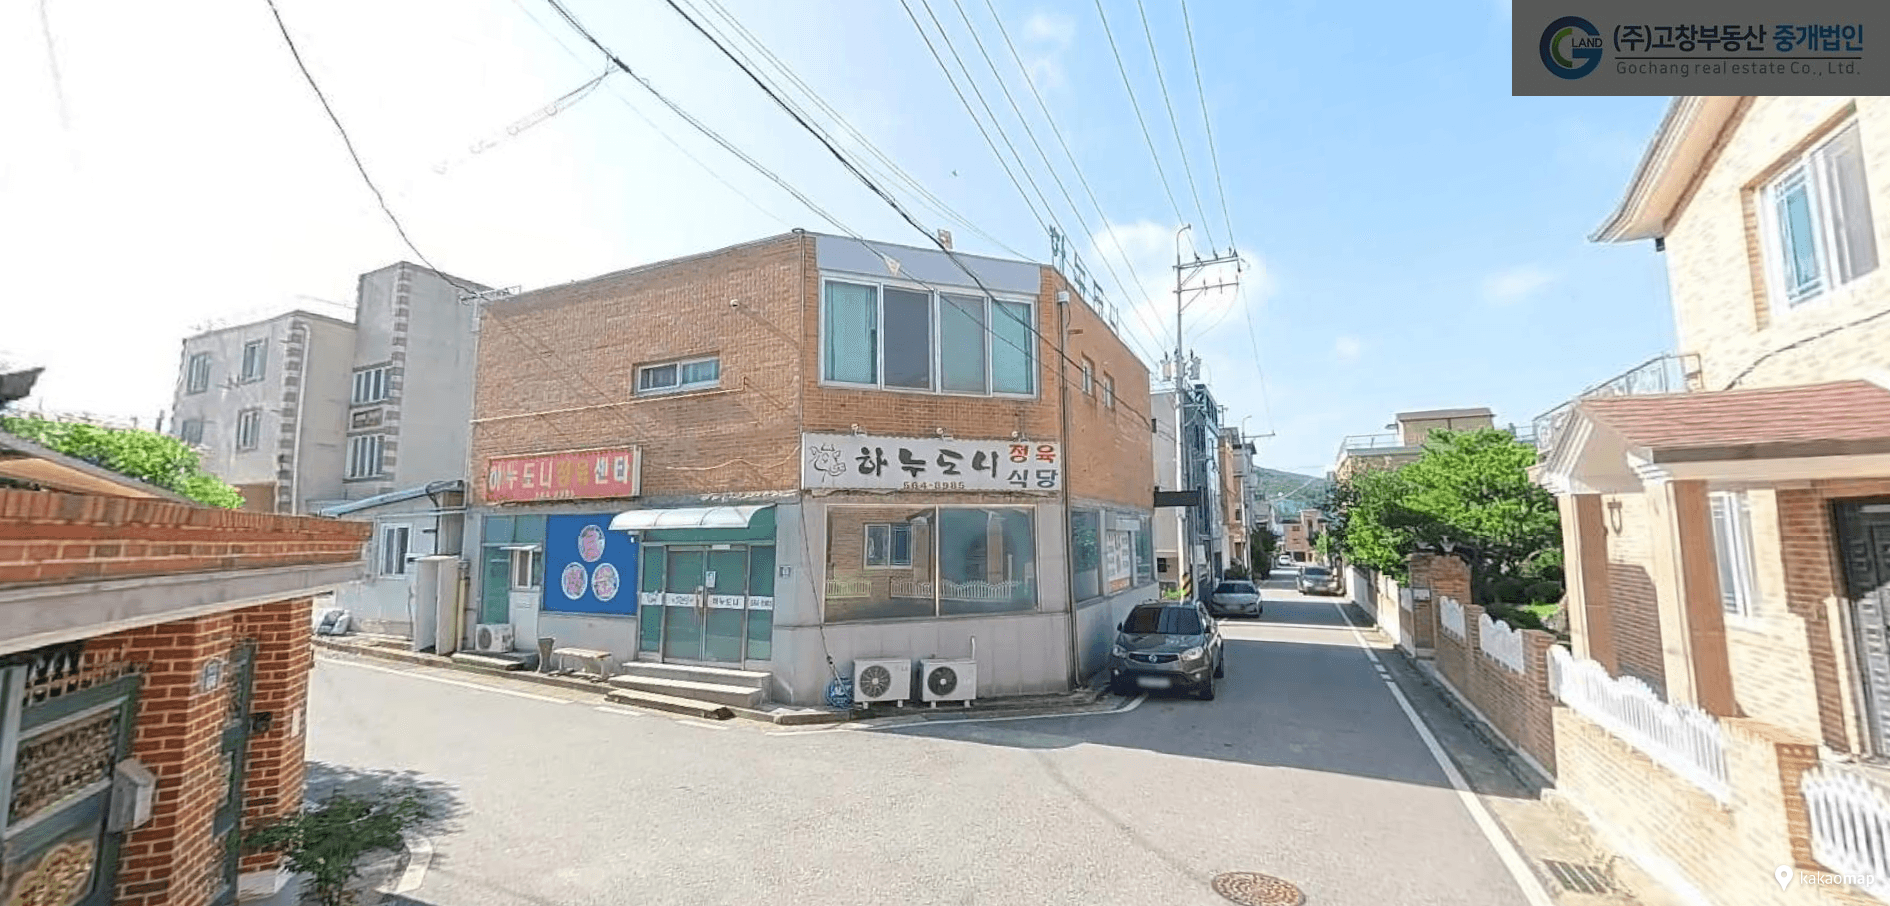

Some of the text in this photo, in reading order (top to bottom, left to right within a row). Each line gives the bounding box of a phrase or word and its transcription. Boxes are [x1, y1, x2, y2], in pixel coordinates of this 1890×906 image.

[855, 446, 999, 478] 하누도니
[1009, 444, 1056, 464] 정육
[1006, 468, 1059, 489] 식당
